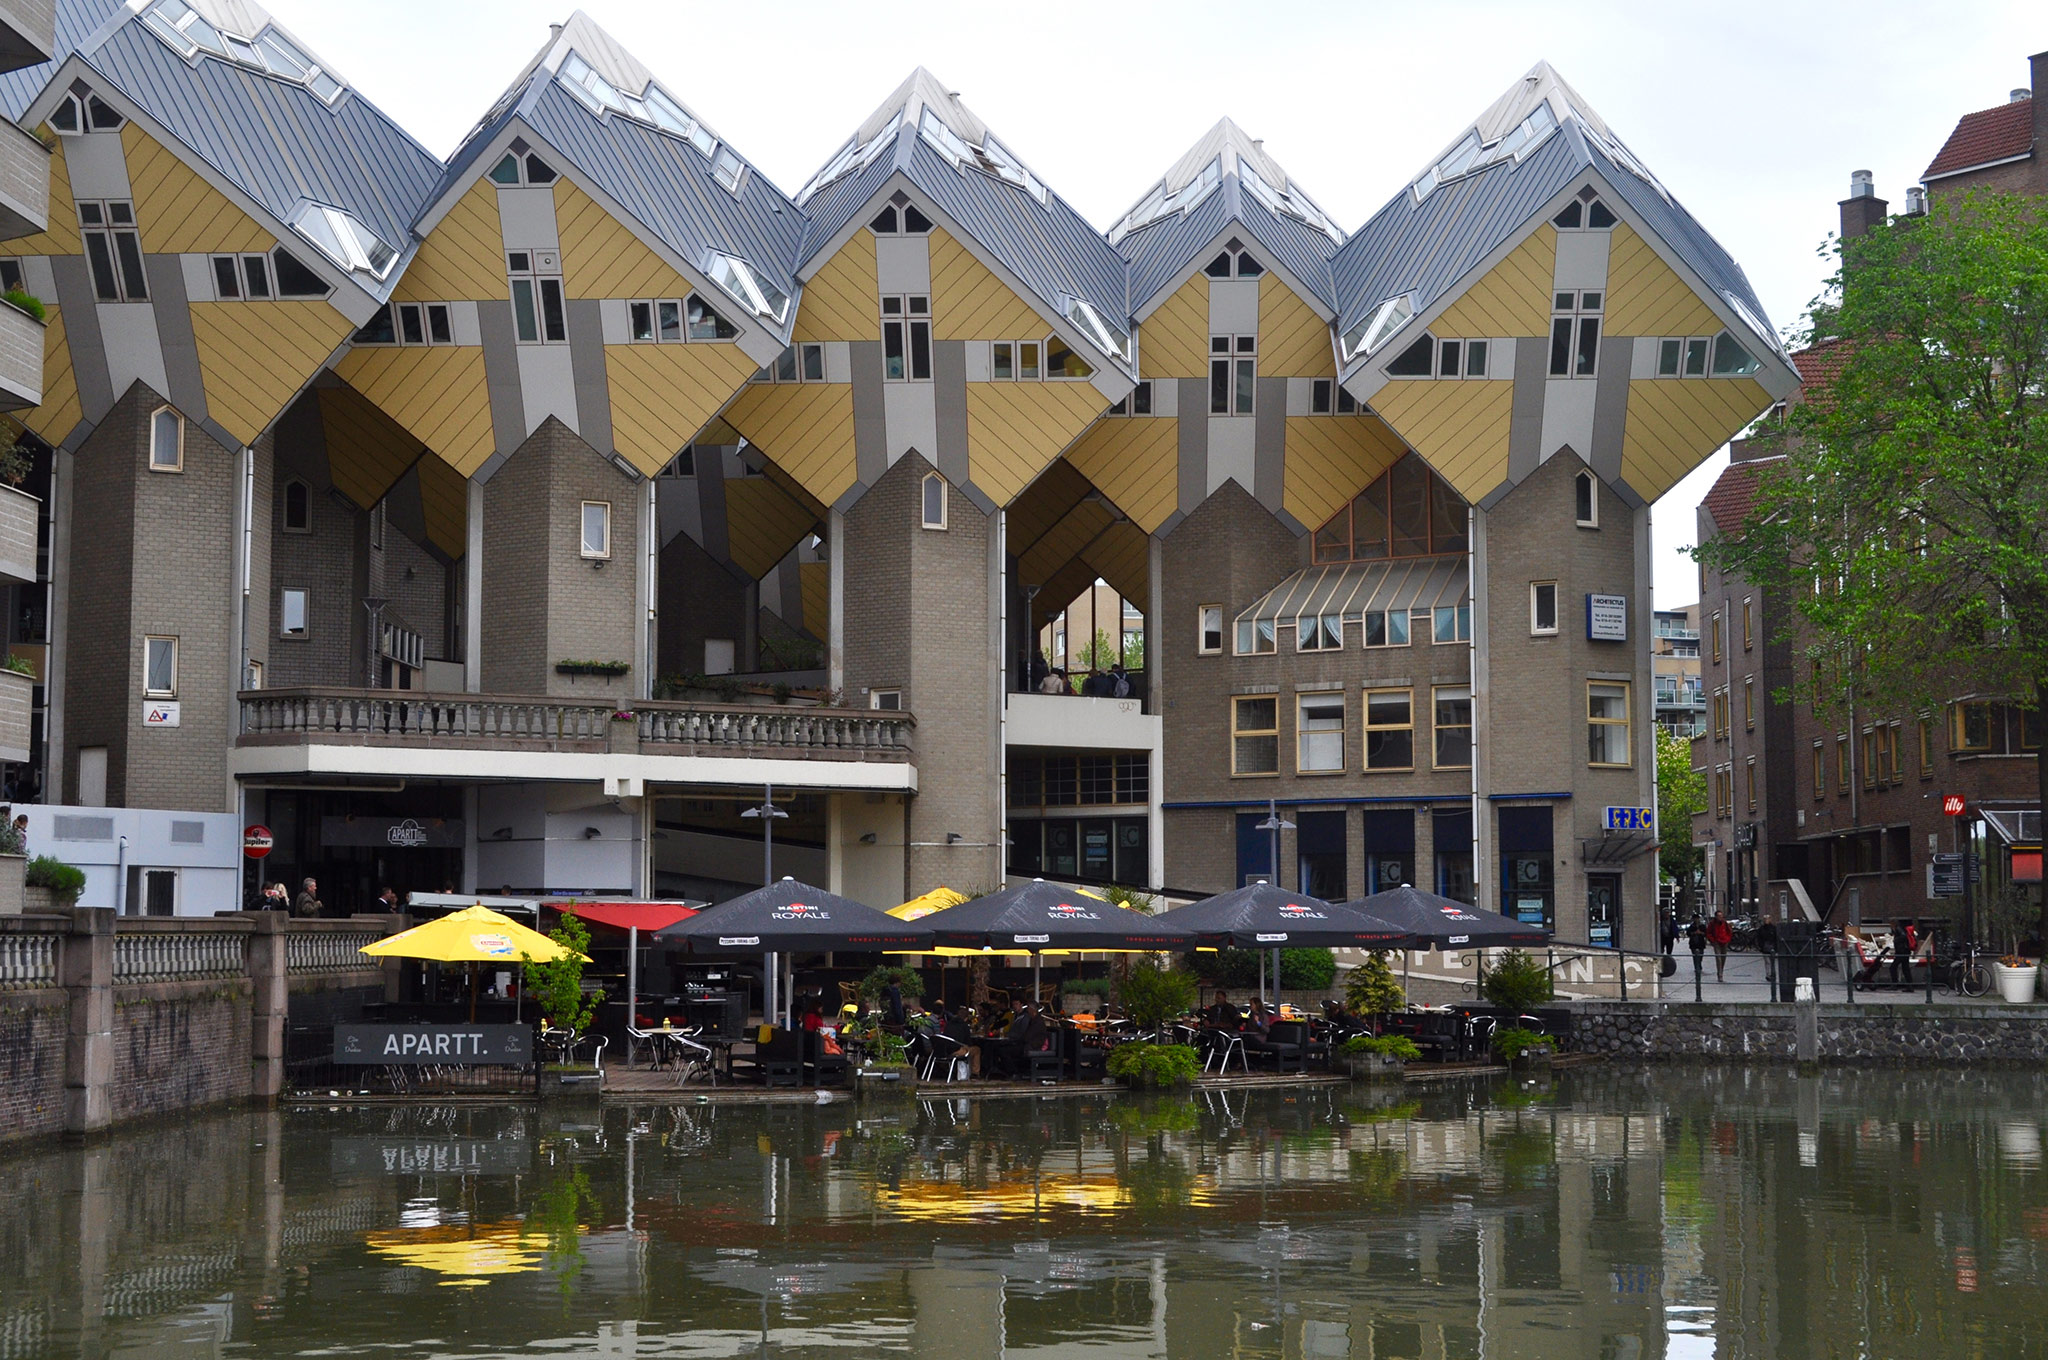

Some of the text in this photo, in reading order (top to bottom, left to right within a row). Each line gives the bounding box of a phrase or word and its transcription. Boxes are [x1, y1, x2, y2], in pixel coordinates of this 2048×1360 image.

[1945, 797, 1964, 814] illy
[391, 829, 418, 840] APARTT
[383, 1033, 488, 1055] APARTT.
